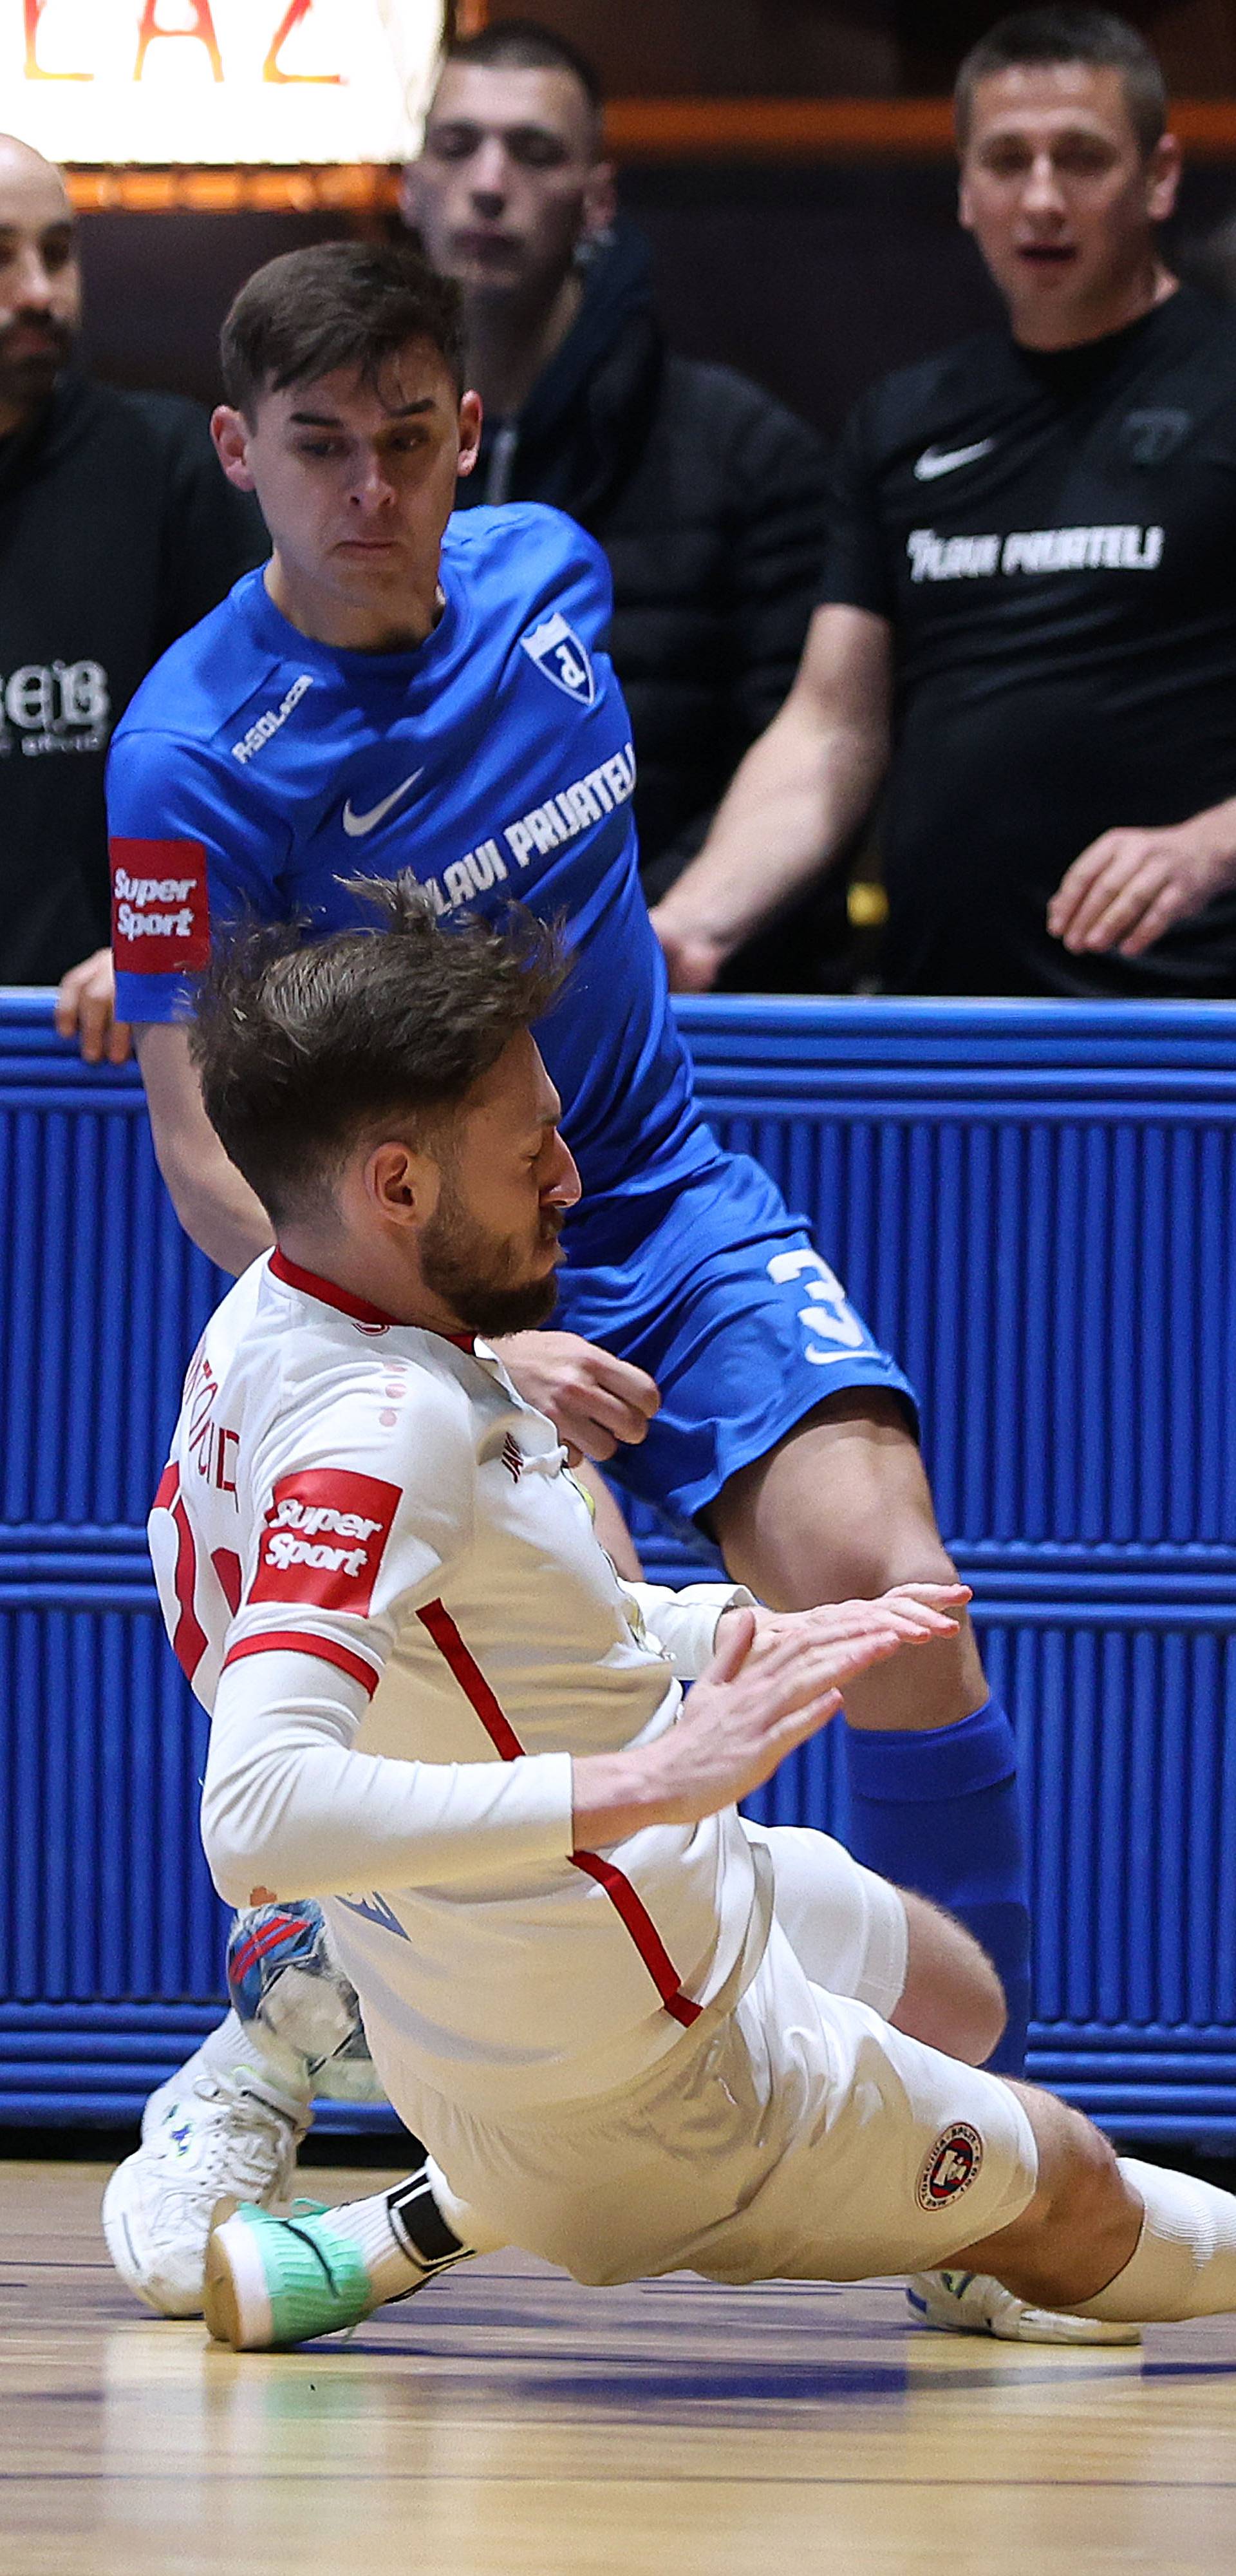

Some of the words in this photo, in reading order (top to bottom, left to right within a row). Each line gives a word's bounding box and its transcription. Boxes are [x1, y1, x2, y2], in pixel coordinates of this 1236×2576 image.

[115, 868, 197, 908] Super
[117, 903, 194, 942] Sport
[766, 1248, 864, 1347] 3
[269, 1499, 383, 1541] Super
[265, 1532, 368, 1577] Sport
